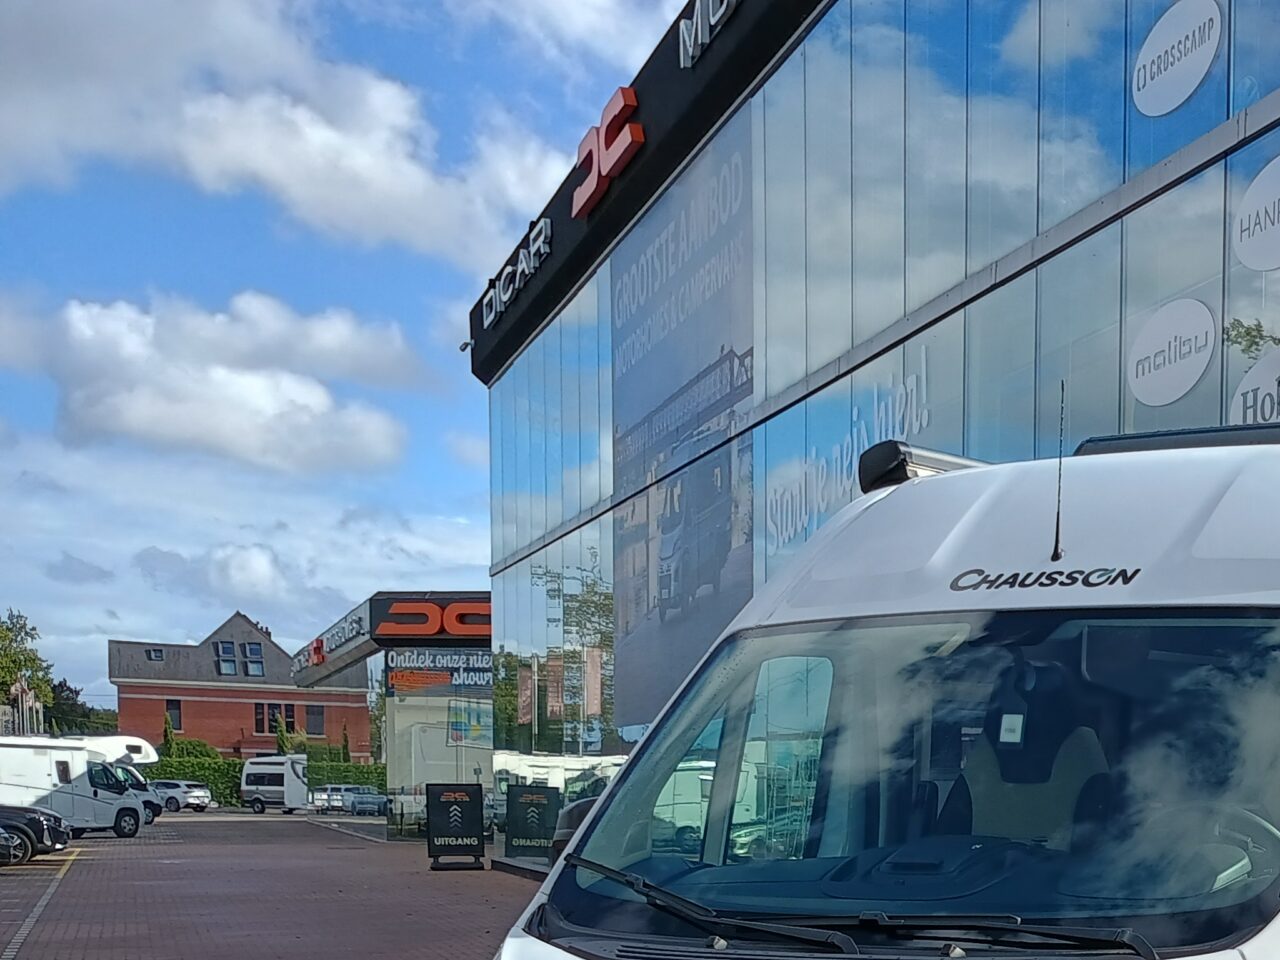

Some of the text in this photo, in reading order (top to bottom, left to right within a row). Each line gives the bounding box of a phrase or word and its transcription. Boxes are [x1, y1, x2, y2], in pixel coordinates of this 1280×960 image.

[1149, 17, 1215, 82] CROSSCAMP
[483, 218, 552, 329] DICAR
[615, 220, 676, 329] GROOTSTE
[1135, 330, 1209, 380] malibu
[950, 568, 1141, 591] CHAUSSON
[388, 650, 492, 668] Ontdek onze nie
[434, 837, 478, 846] UITGANG
